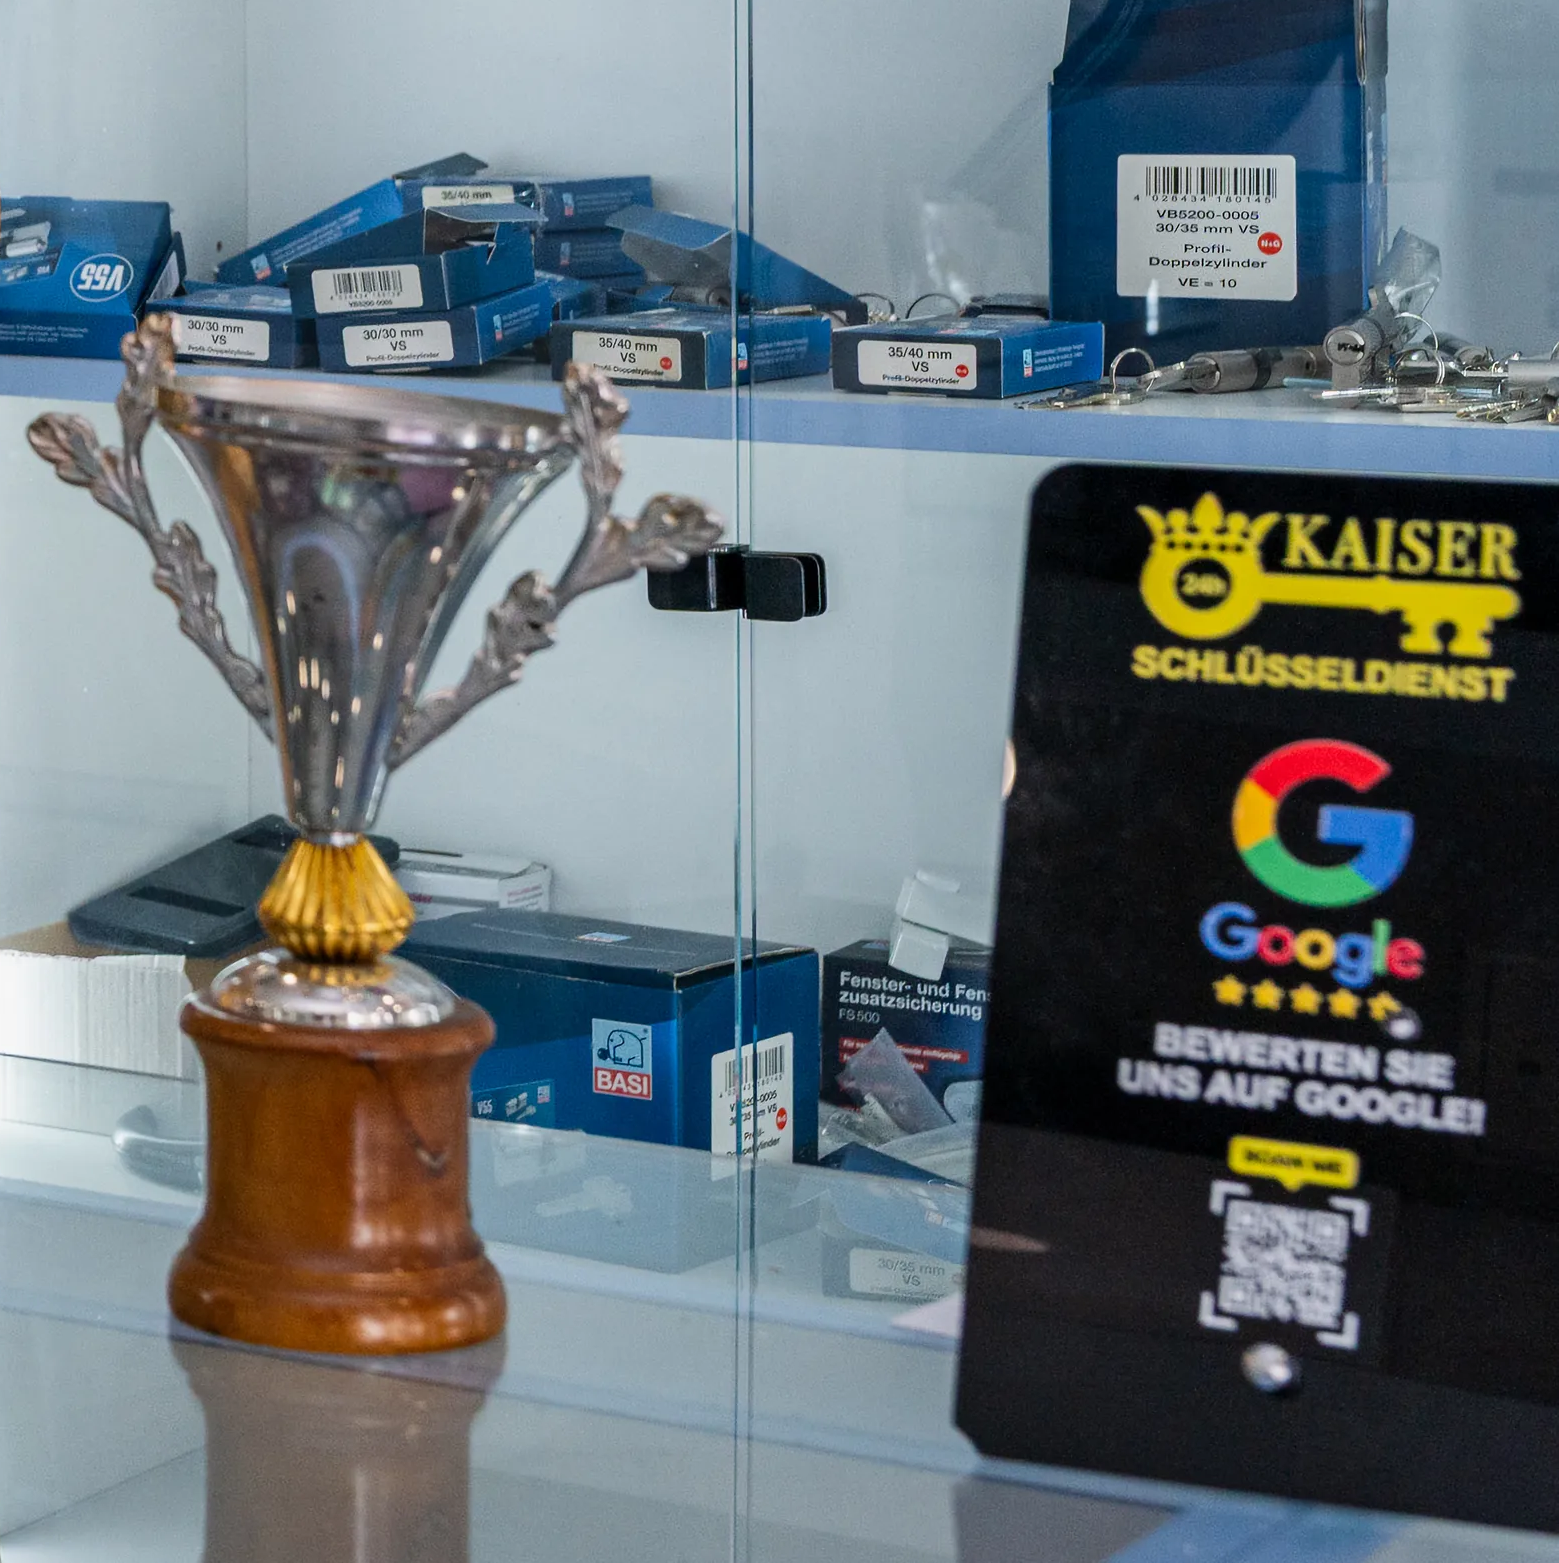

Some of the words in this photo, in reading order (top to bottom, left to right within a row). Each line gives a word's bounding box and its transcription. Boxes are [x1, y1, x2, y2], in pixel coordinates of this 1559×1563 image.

[472, 190, 493, 200] mm
[1155, 208, 1260, 221] VB5200-0005
[1154, 222, 1199, 234] 30/35
[1202, 224, 1234, 234] mm
[1238, 223, 1260, 235] VS
[1183, 243, 1233, 255] Profil-
[1148, 256, 1268, 270] Doppelzylinder
[77, 262, 126, 292] V55
[1177, 277, 1200, 288] VE
[1218, 277, 1238, 289] 10
[187, 319, 219, 333] 30/30
[222, 322, 244, 334] mm
[362, 327, 397, 340] 30/30
[400, 326, 424, 338] mm
[211, 333, 227, 346] VS
[389, 339, 407, 352] VS
[598, 336, 632, 350] 35/40
[634, 341, 659, 353] mm
[619, 351, 637, 364] VS
[887, 346, 924, 359] 35/40
[927, 349, 953, 360] mm
[911, 360, 930, 373] VS
[881, 373, 960, 386] Profil-Doppelzylinder
[1282, 512, 1522, 582] KAISER
[1181, 571, 1228, 598] 24h
[1130, 643, 1515, 703] SCHLÜSSELDIENST
[1198, 901, 1427, 989] Google
[839, 970, 912, 993] Fenster-
[916, 982, 950, 999] und
[954, 983, 992, 1003] Fen
[838, 990, 983, 1021] zusatzsicherung
[838, 1008, 856, 1021] FS
[856, 1010, 881, 1024] 500
[1152, 1020, 1381, 1082] BEWERTEN
[1383, 1048, 1457, 1092] SIE
[596, 1069, 650, 1096] BASI
[1115, 1056, 1202, 1101] UNS
[1202, 1068, 1292, 1111] AUF
[1293, 1079, 1487, 1136] GOOGLE!
[476, 1099, 493, 1115] V55
[919, 1264, 945, 1277] mm
[901, 1273, 922, 1287] VS
